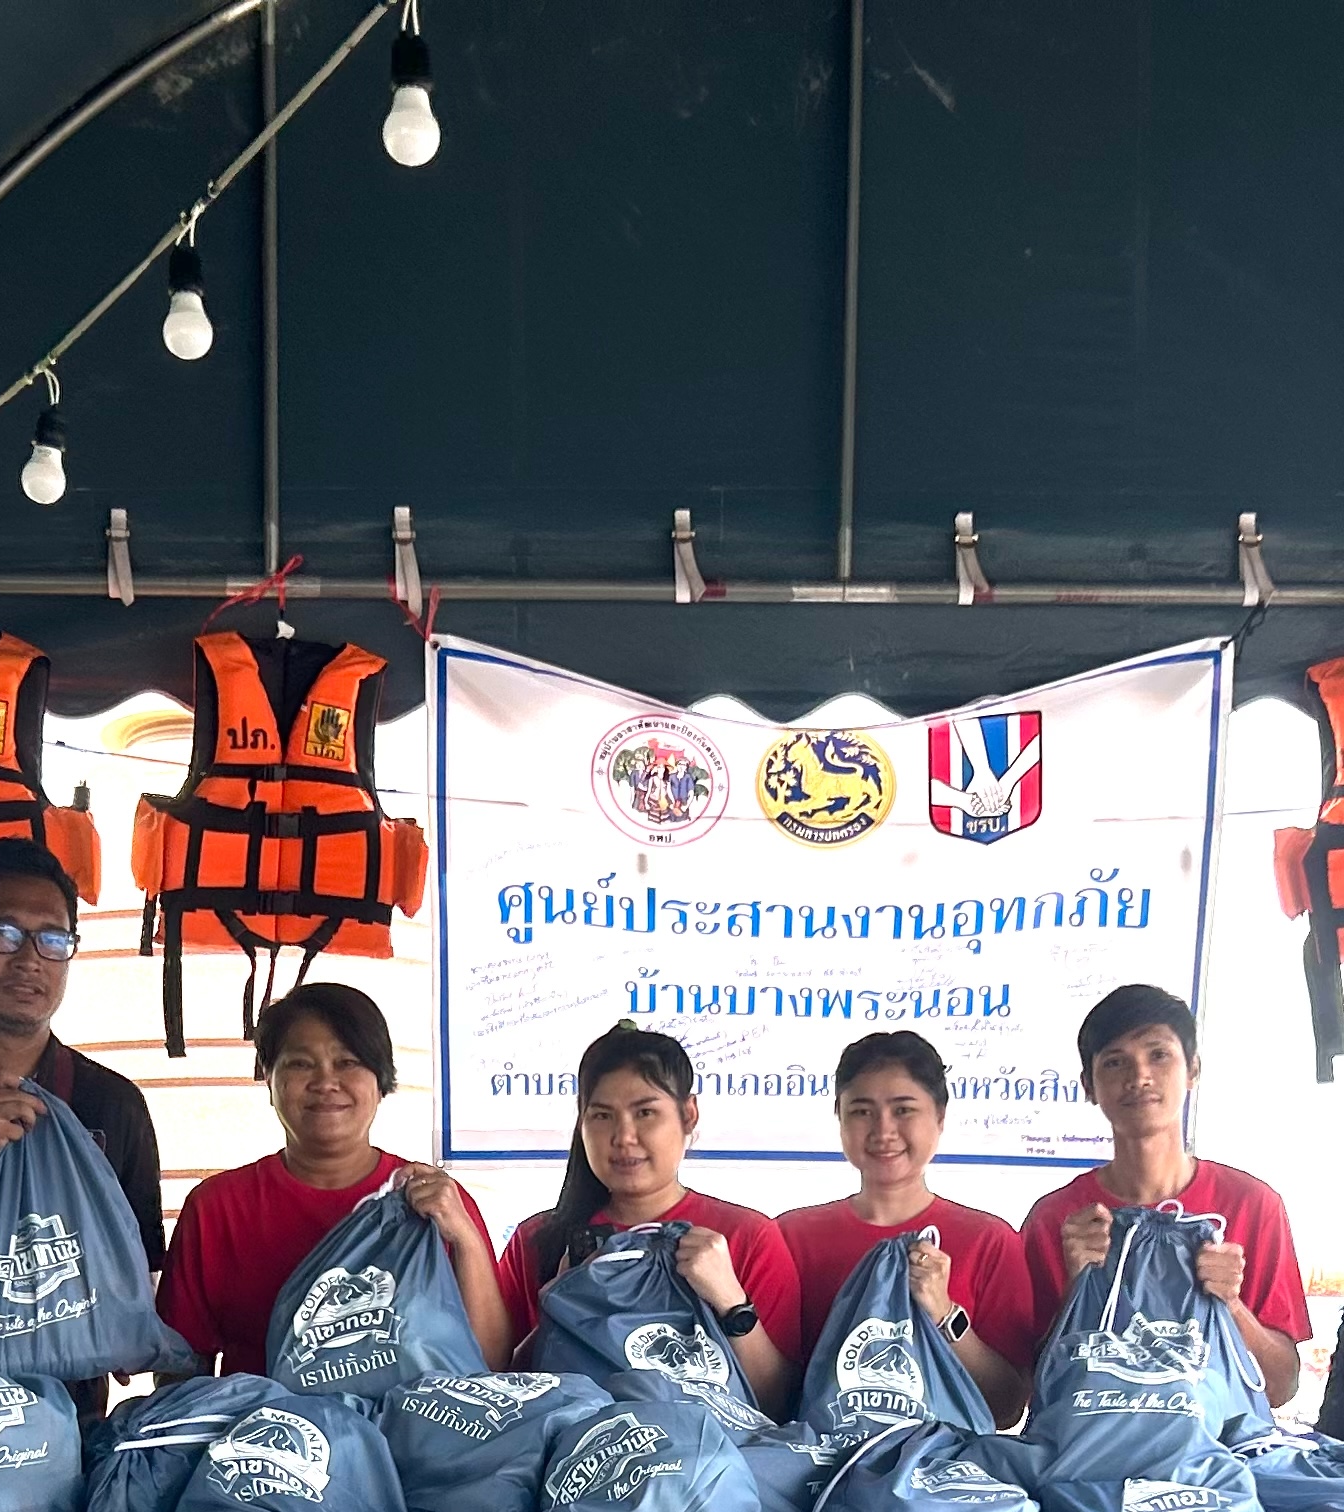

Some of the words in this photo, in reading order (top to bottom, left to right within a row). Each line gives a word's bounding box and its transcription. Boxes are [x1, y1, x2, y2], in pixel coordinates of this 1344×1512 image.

[227, 716, 276, 750] ปภ.
[965, 817, 1006, 834] ชรบ.
[498, 868, 1150, 954] ศูนย์ประสานงานอุทกภัย
[625, 966, 1011, 1019] บ้านบางพระนอน
[301, 1309, 385, 1349] ภูเขาทอง
[300, 1349, 397, 1387] เราไม่ทิ้งกัน
[401, 1396, 492, 1441] เราไม่ทิ้งกัน
[1072, 1390, 1093, 1409] The
[613, 1480, 631, 1499] the
[630, 1459, 683, 1485] Original
